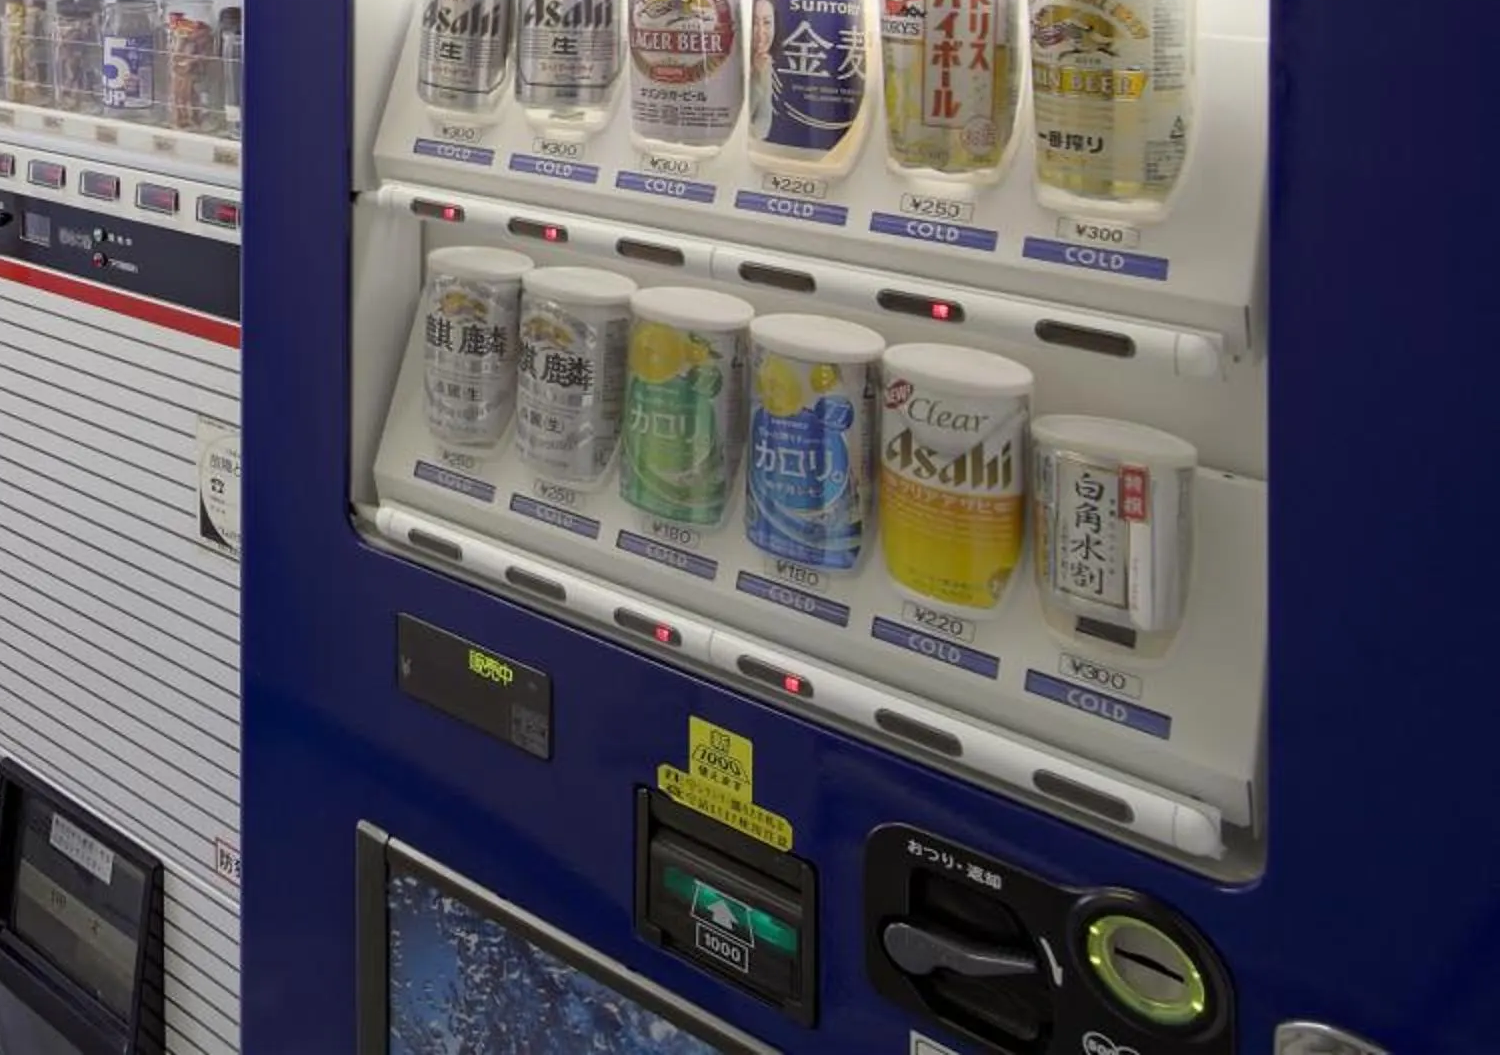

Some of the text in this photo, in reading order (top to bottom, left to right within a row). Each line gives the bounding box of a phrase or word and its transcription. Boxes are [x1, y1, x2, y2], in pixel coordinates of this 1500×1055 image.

[439, 41, 464, 61] 生
[551, 35, 580, 56] 生
[678, 32, 723, 53] BEER
[777, 20, 866, 81] 金麦
[534, 160, 573, 178] COLD
[644, 178, 687, 196] COLD
[771, 175, 816, 195] ¥220
[767, 198, 815, 218] COLD
[906, 220, 960, 243] COLD
[1075, 223, 1123, 244] ¥300
[1065, 246, 1126, 271] COLD
[907, 397, 989, 434] Clear
[885, 427, 1013, 490] Asahi
[1069, 472, 1107, 596] 白角水割
[768, 584, 816, 613] COLD
[914, 606, 964, 636] ¥220
[908, 633, 962, 664] COLD
[1071, 658, 1127, 691] ¥300
[1066, 688, 1128, 723] COLD
[907, 840, 1003, 891] おつり・返却
[703, 933, 741, 963] 1000
